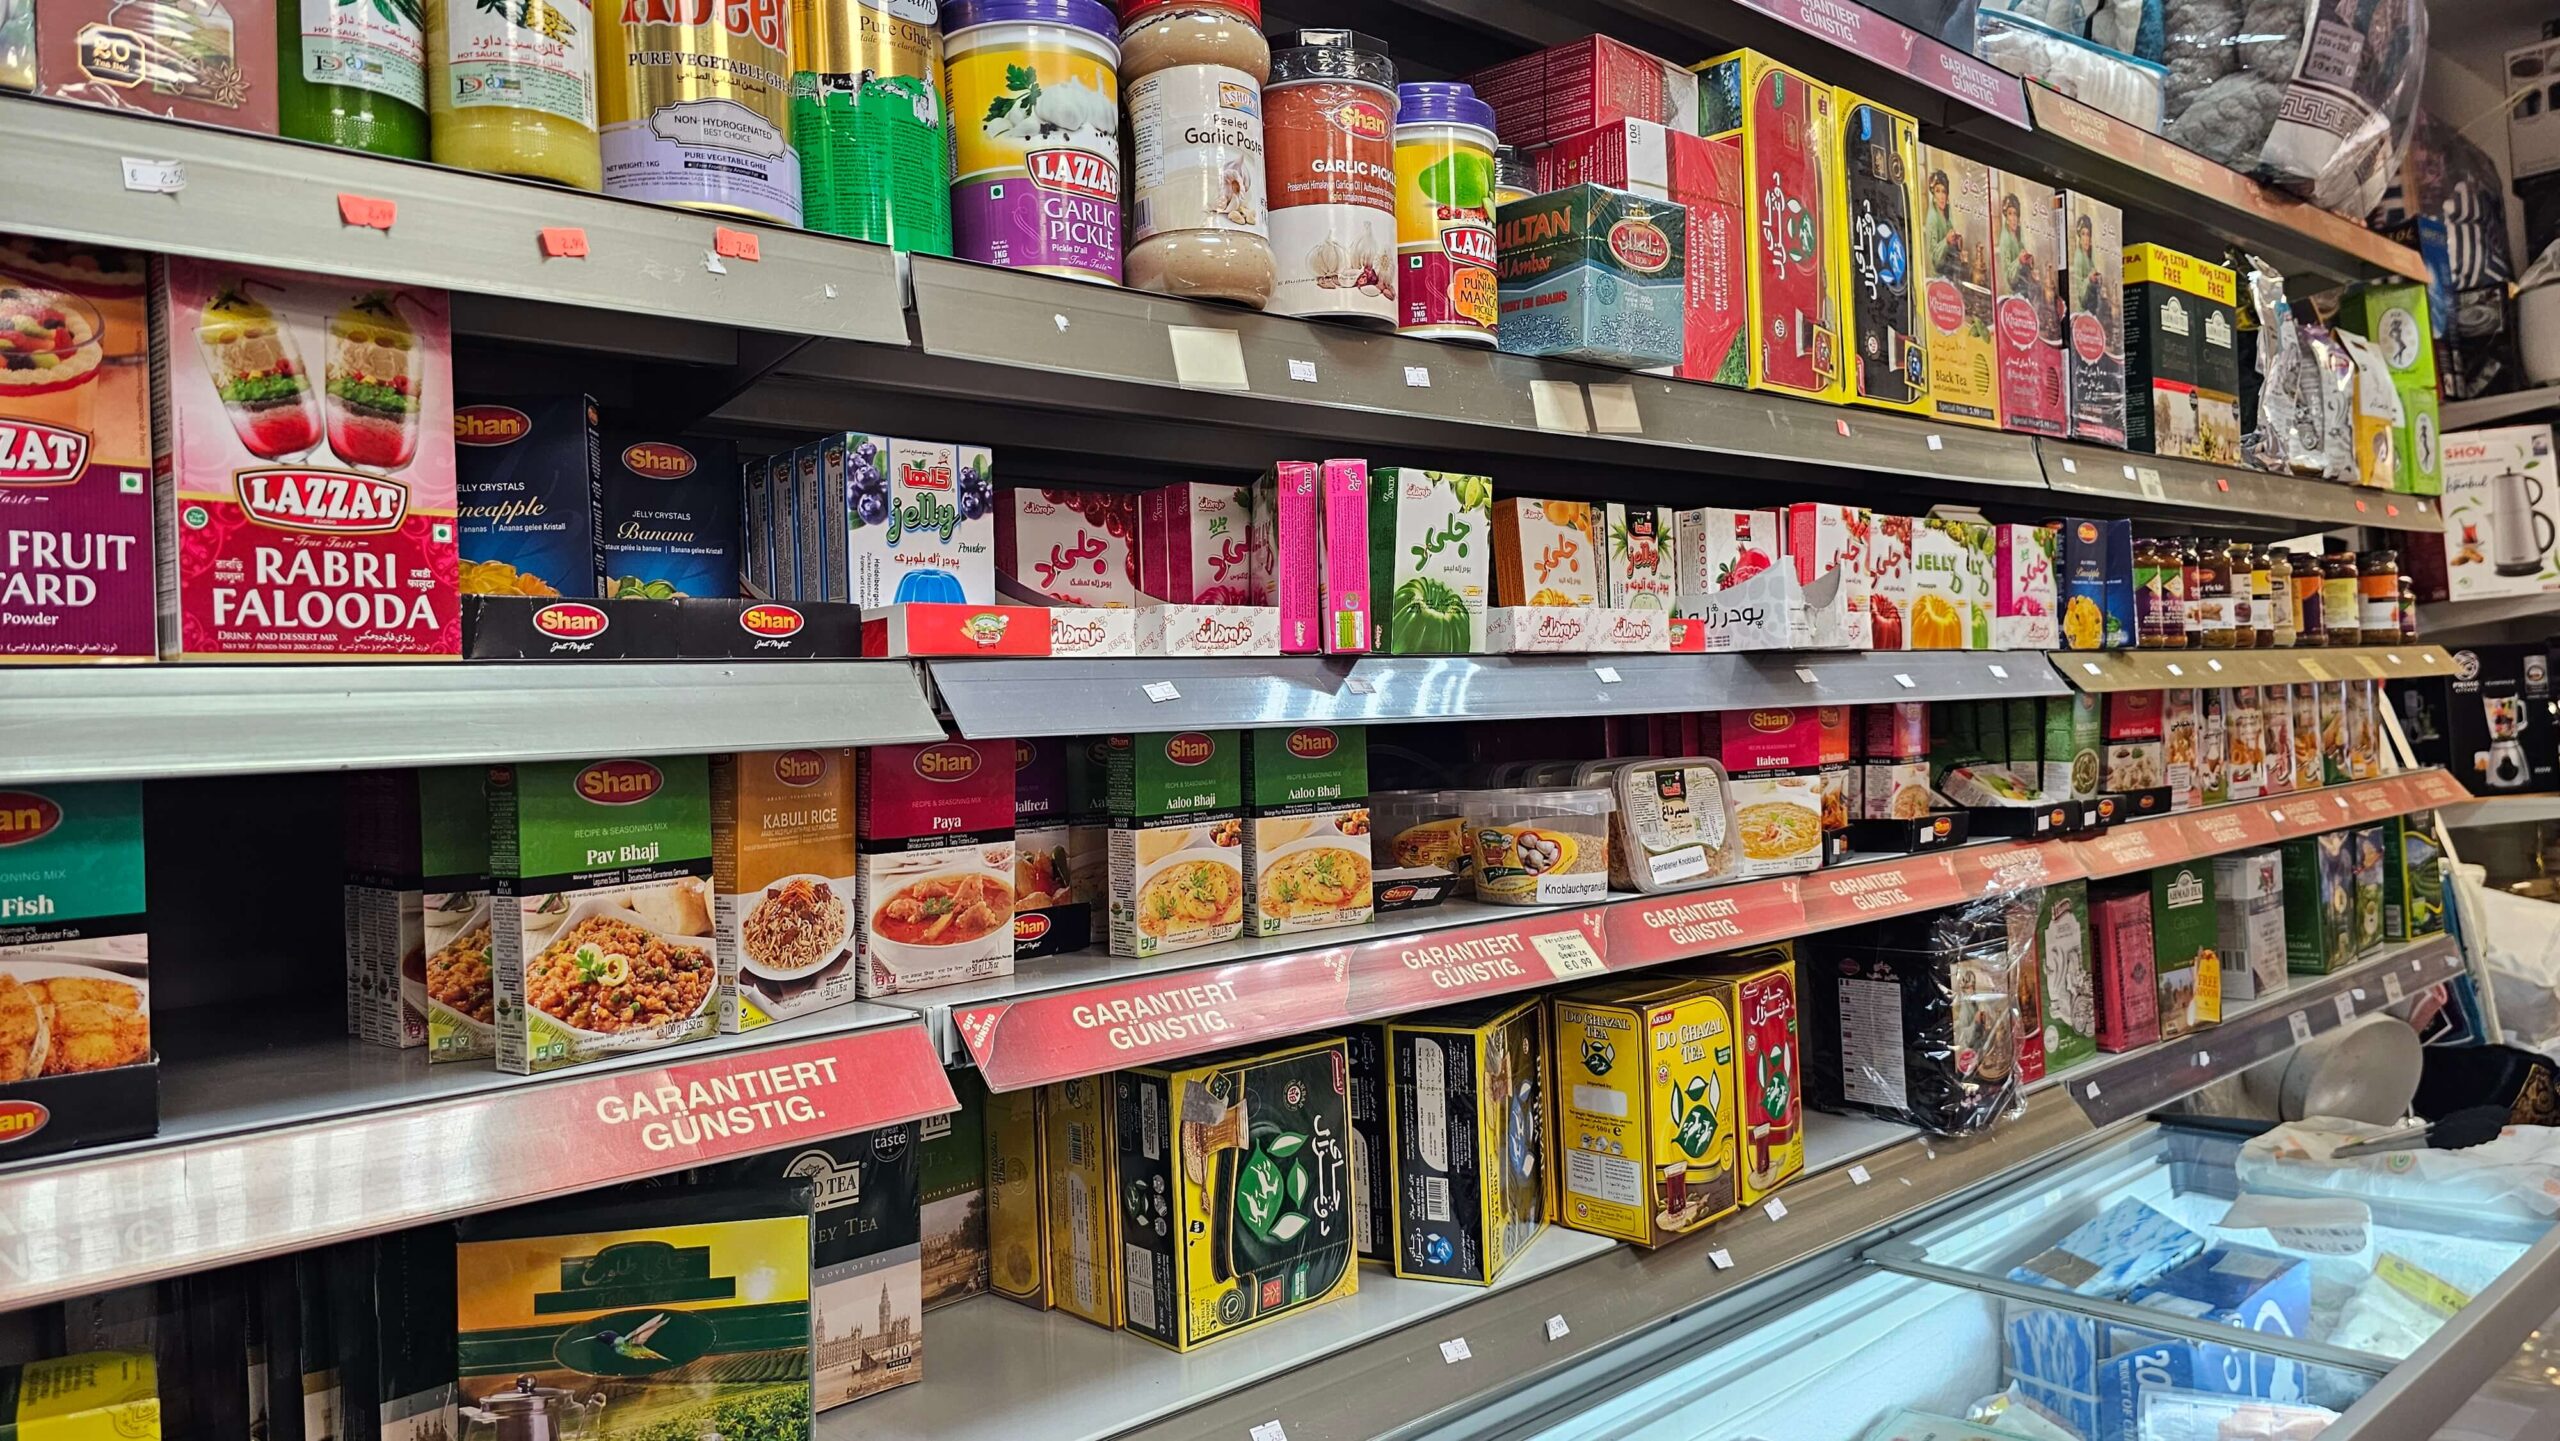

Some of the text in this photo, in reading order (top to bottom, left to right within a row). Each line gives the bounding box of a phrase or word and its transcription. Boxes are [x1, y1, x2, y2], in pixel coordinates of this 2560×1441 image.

[860, 16, 932, 50] Pure Ghee
[475, 50, 503, 58] SAUCE
[629, 52, 764, 81] PURE VEGETABLE
[1941, 54, 2000, 91] GARANTIERT
[1952, 74, 1998, 106] GÜNSTIG.
[702, 117, 772, 140] HYDROGENATED
[1213, 114, 1248, 129] Peeled
[1339, 106, 1386, 135] Shan
[703, 127, 752, 143] BEST CHOICE
[1185, 127, 1263, 156] Garlic Paste
[606, 164, 618, 173] NET
[645, 160, 660, 168] 1KG
[684, 151, 706, 160] PURE
[707, 153, 749, 167] VEGETABLE
[750, 161, 768, 171] GHEE
[1311, 159, 1368, 175] GARLIC
[1036, 154, 1118, 196] LAZZAT
[1044, 198, 1116, 231] GARLIC
[1051, 220, 1115, 252] PICKLE
[1498, 205, 1572, 250] ULTAN
[1052, 244, 1073, 253] Pickle
[2170, 252, 2189, 269] EXTRA
[1476, 271, 1489, 280] HOT
[2163, 266, 2181, 285] FREE
[2214, 267, 2231, 284] EXTRA
[2208, 281, 2225, 299] FREE
[1474, 304, 1494, 317] PICKLE
[1936, 371, 1968, 387] Black Tea
[454, 418, 518, 436] Shan
[628, 449, 688, 471] Shan
[457, 482, 526, 493] ELLY CRYSTALS
[250, 475, 399, 521] LAZZAT
[457, 495, 548, 525] ineapple
[632, 510, 691, 521] JELLY CRYSTALS
[886, 491, 962, 545] jelly
[499, 524, 524, 532] Ananas
[543, 523, 566, 531] Kristall
[616, 520, 697, 543] Banana
[9, 530, 137, 572] FRUIT
[295, 534, 358, 550] True Taste
[705, 547, 723, 555] Kristall
[958, 542, 987, 554] Powder
[255, 546, 398, 590] RABRI
[1626, 542, 1660, 580] jelly
[1915, 553, 1957, 572] JELLY
[1950, 572, 1963, 594] D
[212, 588, 440, 630] FALOODA
[1721, 607, 1765, 629] پودر
[3, 612, 59, 627] Powder
[541, 610, 600, 631] Shan
[746, 610, 796, 629] Shan
[217, 629, 338, 642] DRINK AND DESSERT MIX
[1754, 712, 1790, 727] Shan
[1171, 740, 1209, 757] Shan
[1292, 733, 1332, 751] Shan
[780, 758, 820, 777] Shan
[921, 752, 973, 772] Shan
[1756, 755, 1790, 767] Haleem
[584, 770, 652, 794] Shan
[1166, 792, 1216, 809] Aaloo Bhaji
[1288, 784, 1341, 800] Aaloo Bhaji
[0, 805, 42, 831] an
[763, 807, 838, 830] KABULI RICE
[933, 815, 962, 831] Paya
[574, 822, 668, 839] RECIPE & SEASONING MIX
[587, 842, 660, 866] Pav Bhaji
[44, 869, 67, 881] MIX
[1829, 870, 1906, 897] GARANTIERT
[1852, 885, 1914, 912] GÜNSTIG.
[2169, 886, 2189, 901] AHMAD
[2, 895, 55, 919] Fish
[1642, 898, 1740, 929] GARANTIERT
[62, 928, 80, 939] Fisch
[1014, 921, 1045, 935] Shan
[1669, 918, 1744, 945] GÜNSTIG.
[1401, 932, 1525, 970] GARANTIERT
[1558, 942, 1576, 951] Shan
[1558, 949, 1588, 960] Gewürze
[1431, 956, 1527, 990] GÜNSTIG.
[1072, 980, 1239, 1029] GARANTIERT
[962, 1013, 976, 1031] GUT
[1564, 1009, 1631, 1031] DO GHAZAL
[1651, 1011, 1673, 1025] AKBAR
[664, 1023, 676, 1038] 100
[974, 1012, 996, 1050] GÜNSTIG
[1108, 1009, 1235, 1051] GÜNSTIG.
[1585, 1025, 1609, 1040] TEA
[1656, 1018, 1724, 1051] DO GHAZAL
[1680, 1045, 1707, 1064] TEA
[597, 1056, 839, 1125] GARANTIERT
[0, 1110, 36, 1131] an
[642, 1094, 826, 1152] GÜNSTIG.
[874, 1130, 907, 1149] taste
[881, 1125, 899, 1138] great
[827, 1174, 857, 1194] TEA
[844, 1216, 879, 1238] TEA
[821, 1256, 887, 1279] LOVE OF TEA
[889, 1344, 909, 1361] 110
